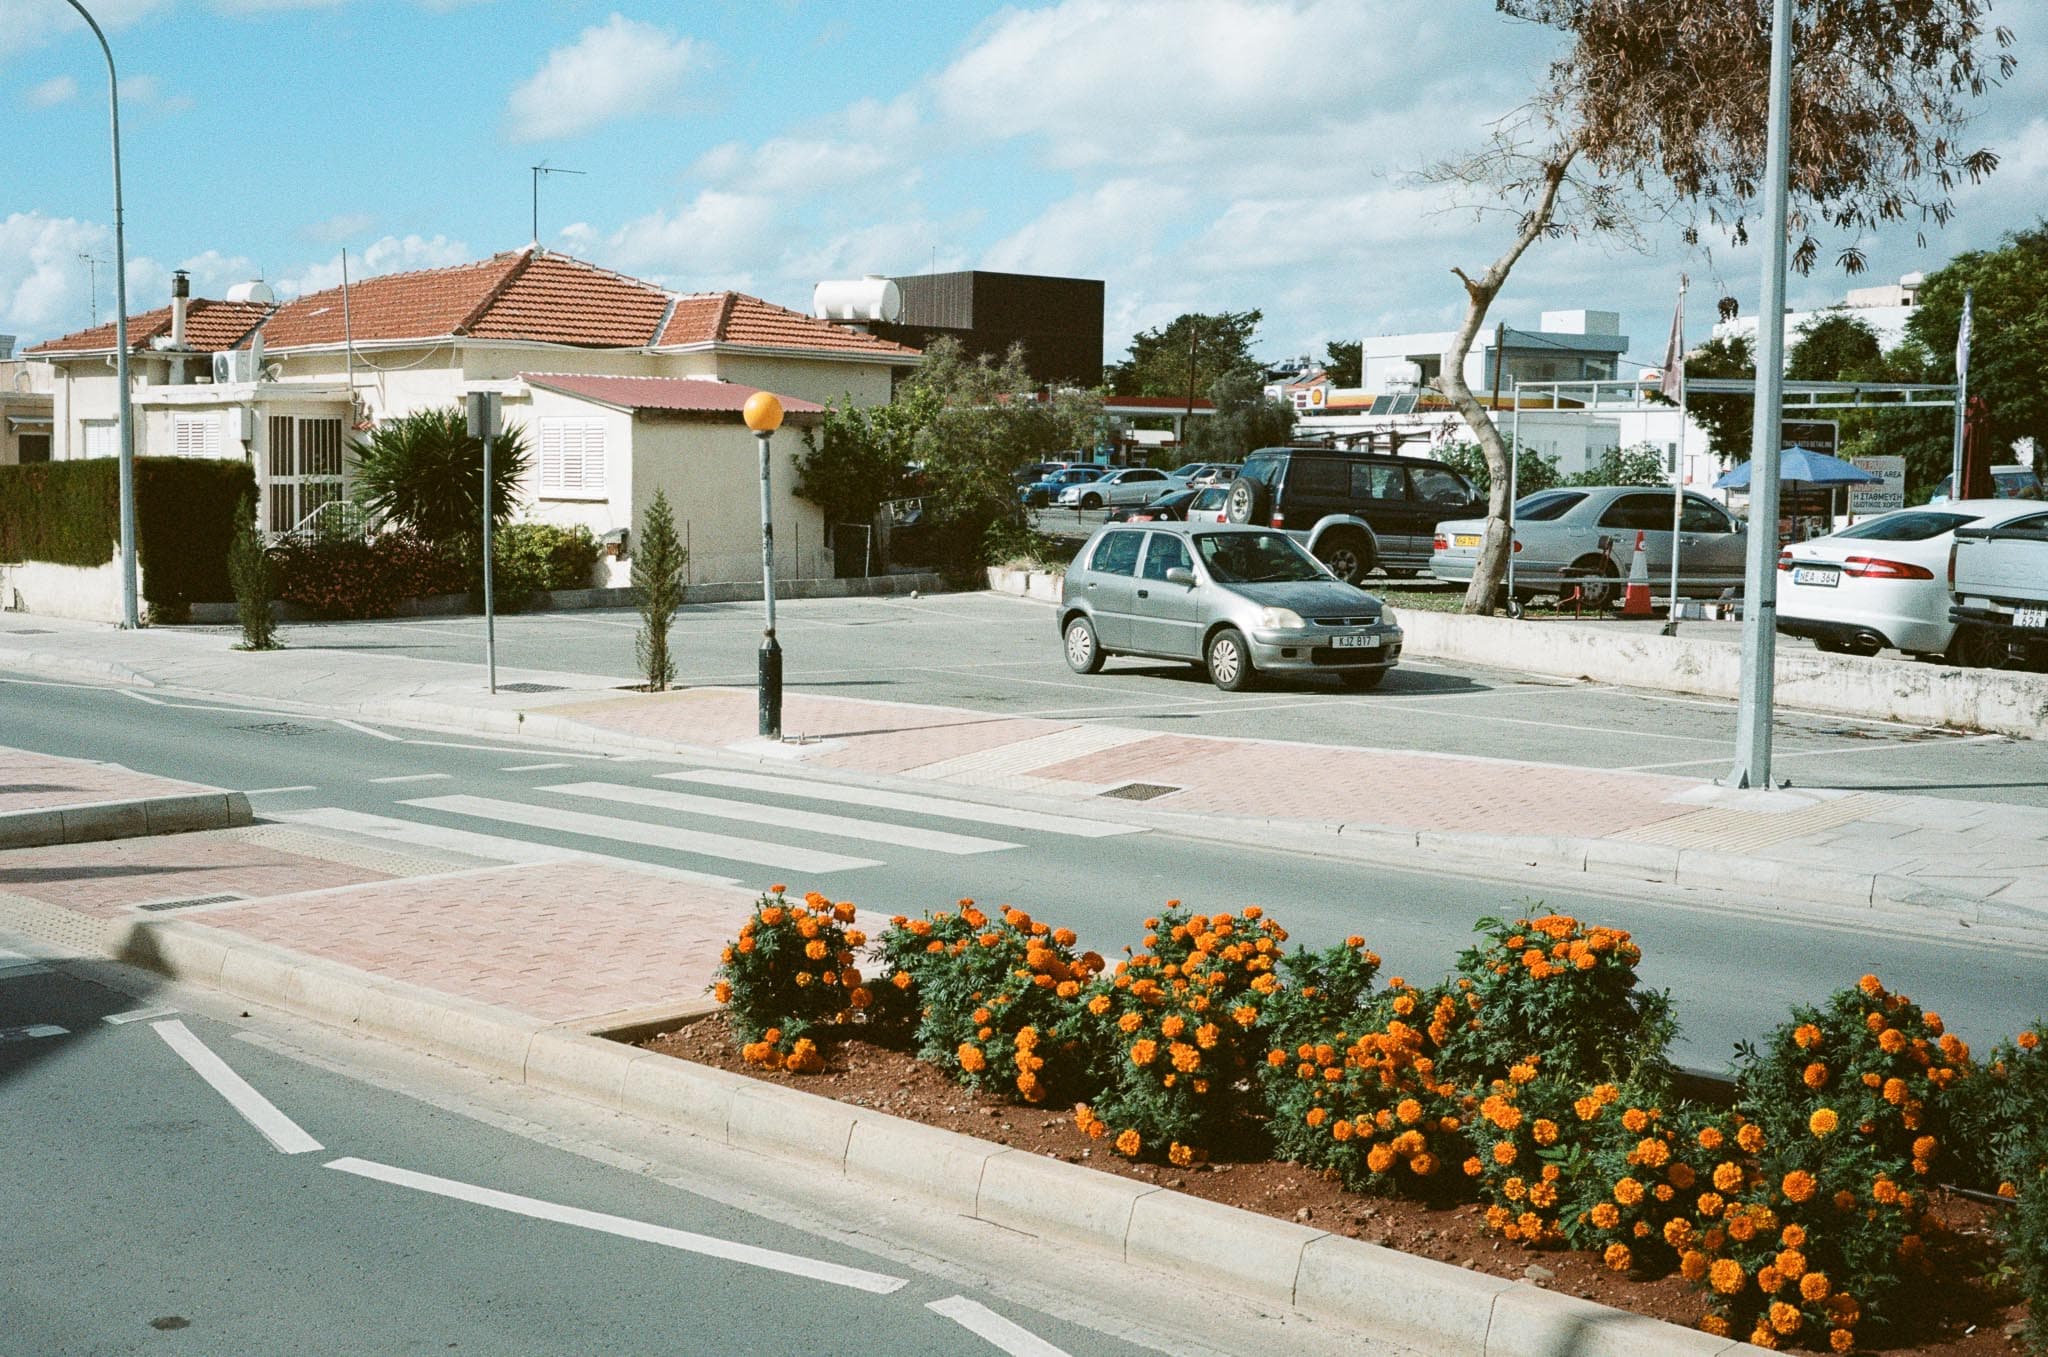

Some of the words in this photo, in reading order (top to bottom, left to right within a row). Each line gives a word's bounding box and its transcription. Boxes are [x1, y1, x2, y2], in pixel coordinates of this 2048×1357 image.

[1820, 572, 1836, 583] 364
[2022, 616, 2040, 627] 626
[1339, 636, 1354, 646] KJZ
